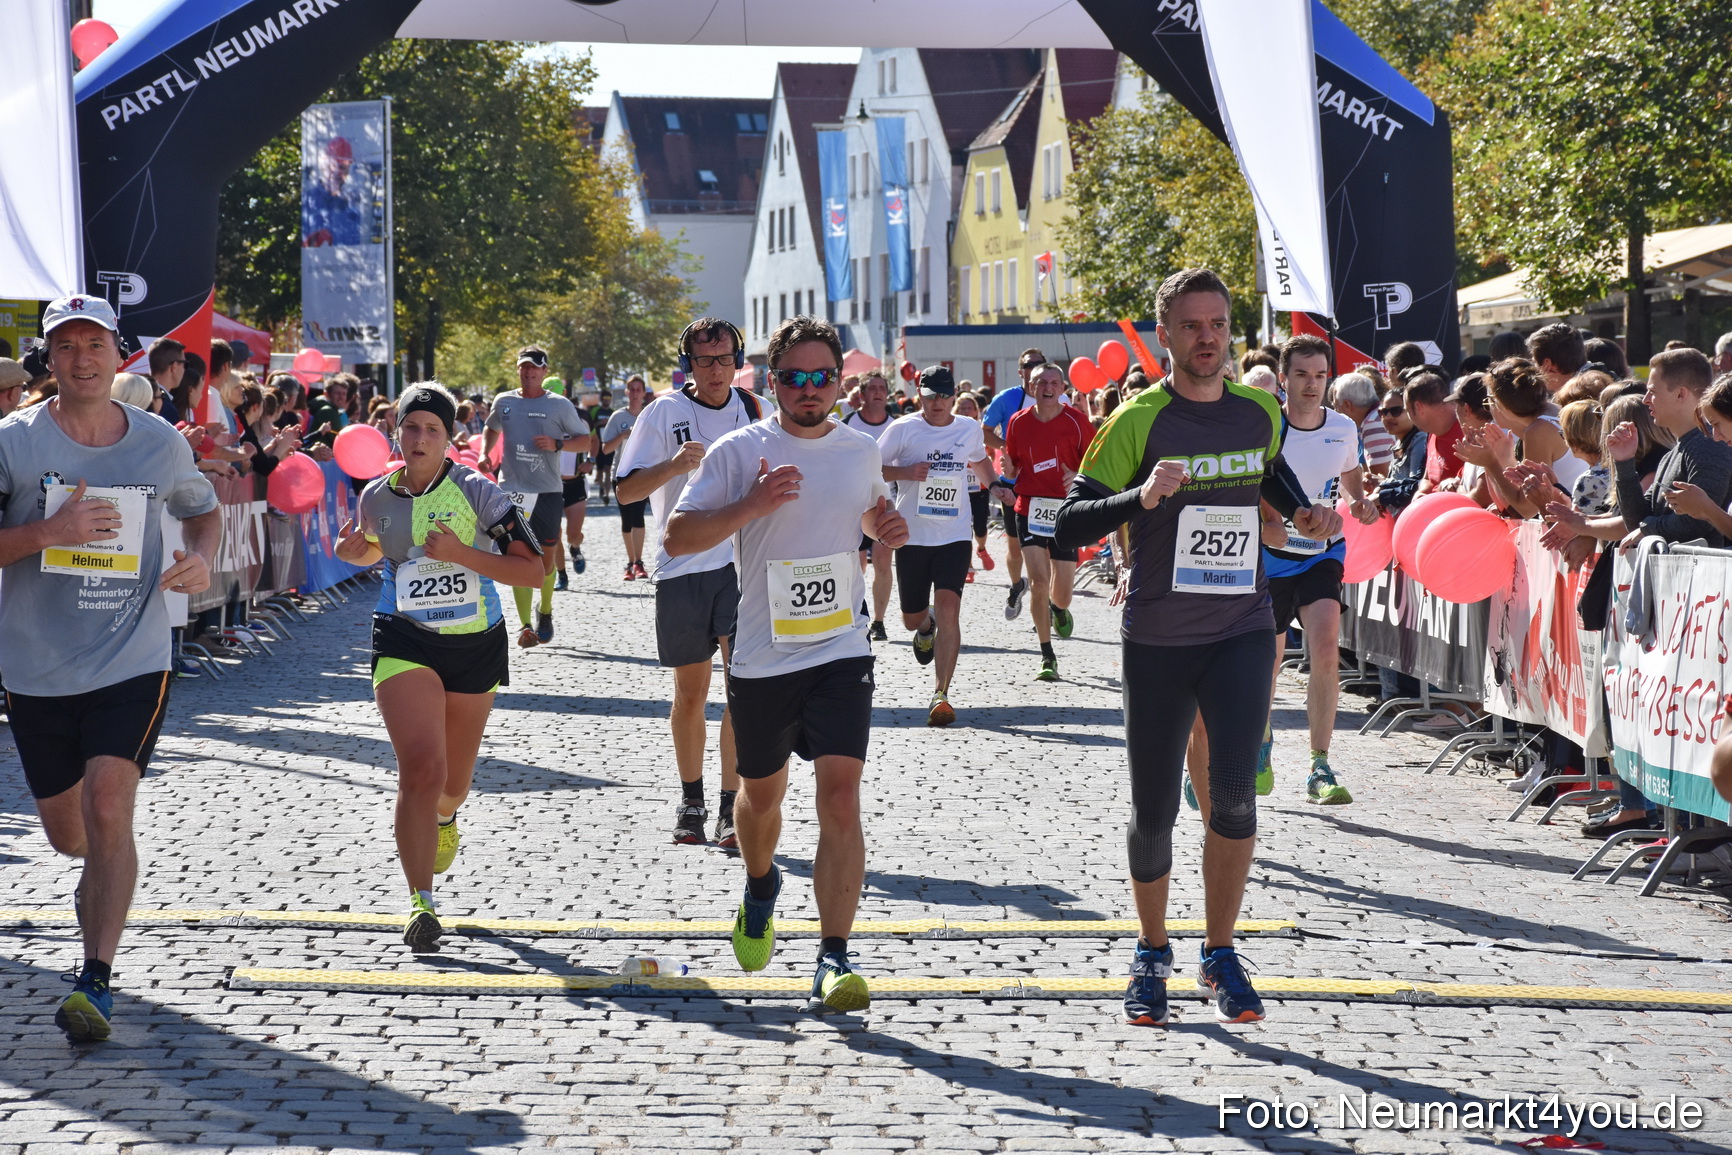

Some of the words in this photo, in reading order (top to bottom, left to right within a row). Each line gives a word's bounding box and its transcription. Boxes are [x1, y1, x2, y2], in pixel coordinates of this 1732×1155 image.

[100, 69, 198, 131] PARTL
[193, 0, 351, 79] NEUMARK
[671, 420, 690, 429] JOGIS
[673, 426, 693, 446] 11
[1200, 481, 1212, 491] by
[1213, 479, 1240, 489] smart
[925, 486, 957, 502] 2607
[1034, 507, 1057, 522] 245
[1205, 513, 1242, 523] BOCK
[86, 543, 115, 551] Neumarkt
[1189, 529, 1251, 557] 2527
[1285, 538, 1318, 549] hristoph
[71, 554, 114, 568] Helmut
[417, 561, 455, 573] BOCK
[793, 563, 832, 576] BOCK
[1203, 572, 1237, 584] Martin
[408, 572, 468, 599] 2235
[790, 577, 836, 608] 329
[77, 599, 125, 610] Stadtlauf
[433, 598, 458, 606] Neumarkt
[426, 610, 455, 620] Laura
[809, 606, 833, 616] Neumarkt
